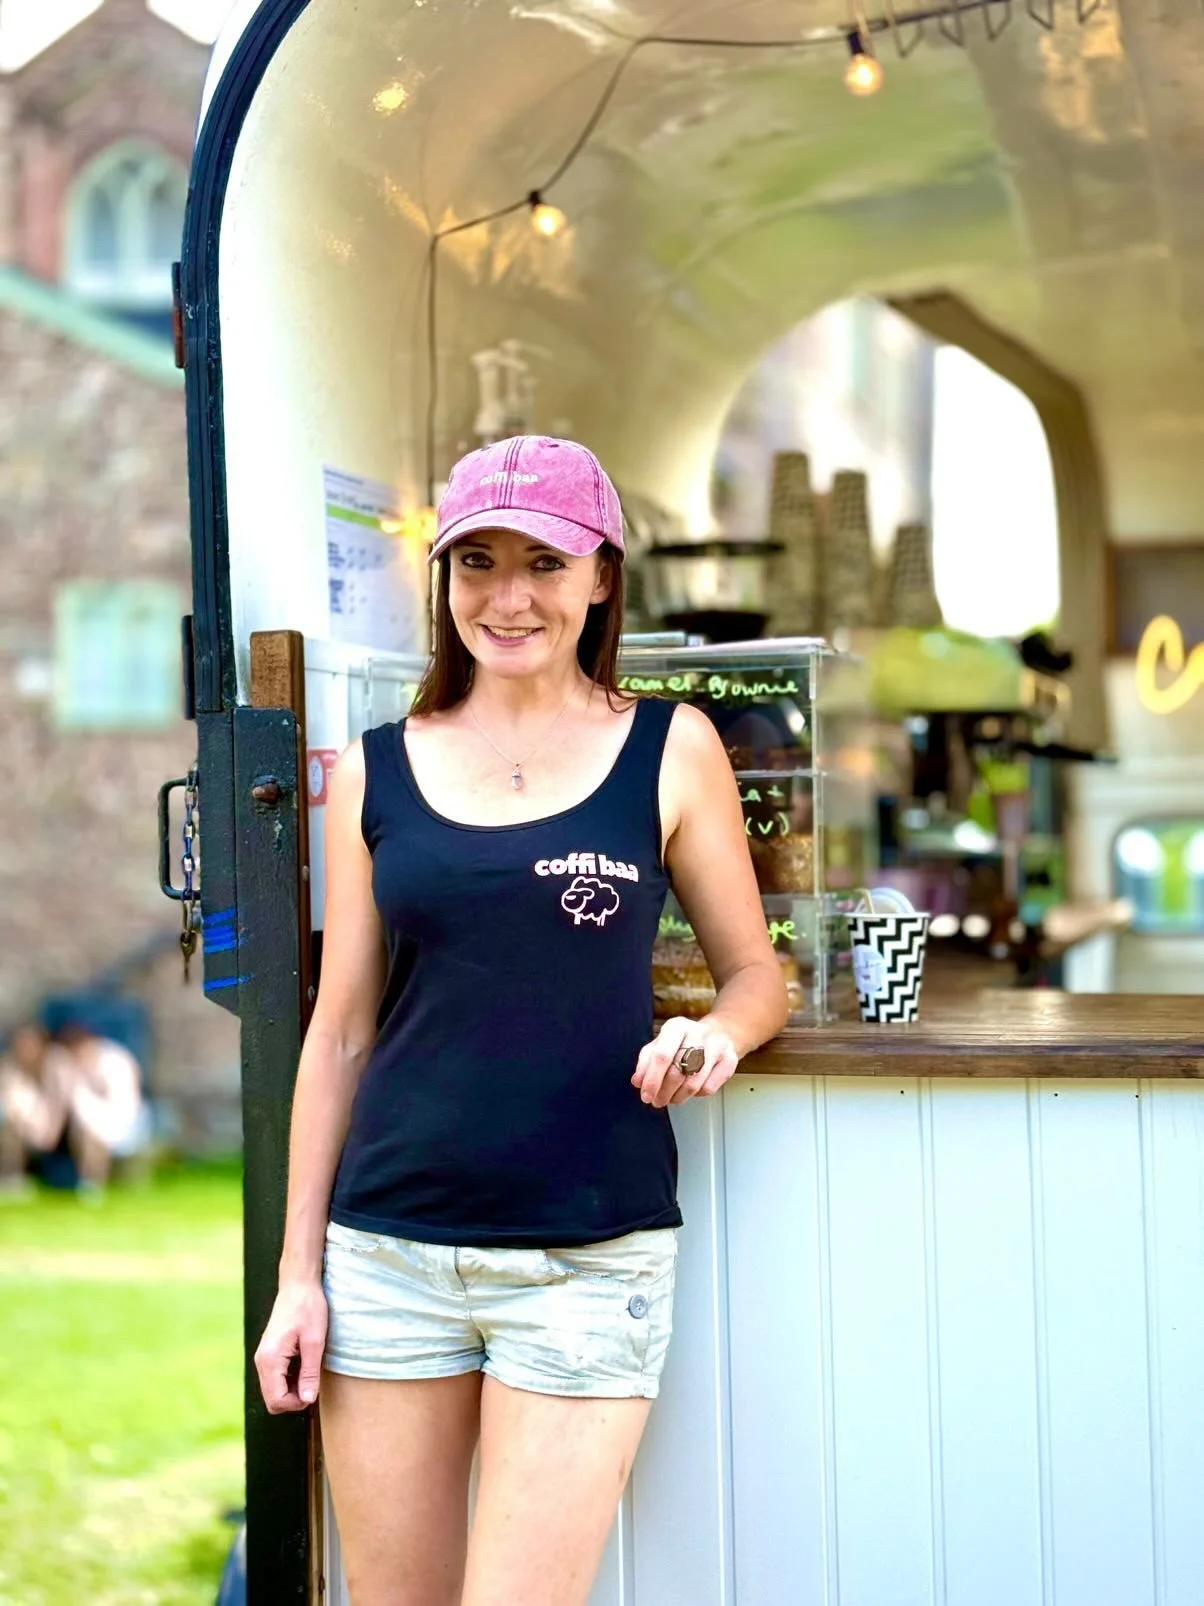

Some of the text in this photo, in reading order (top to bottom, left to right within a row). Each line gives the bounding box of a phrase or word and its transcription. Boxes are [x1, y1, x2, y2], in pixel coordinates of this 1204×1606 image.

[513, 470, 540, 483] baa
[1136, 614, 1204, 715] C
[534, 853, 639, 882] coffi baa
